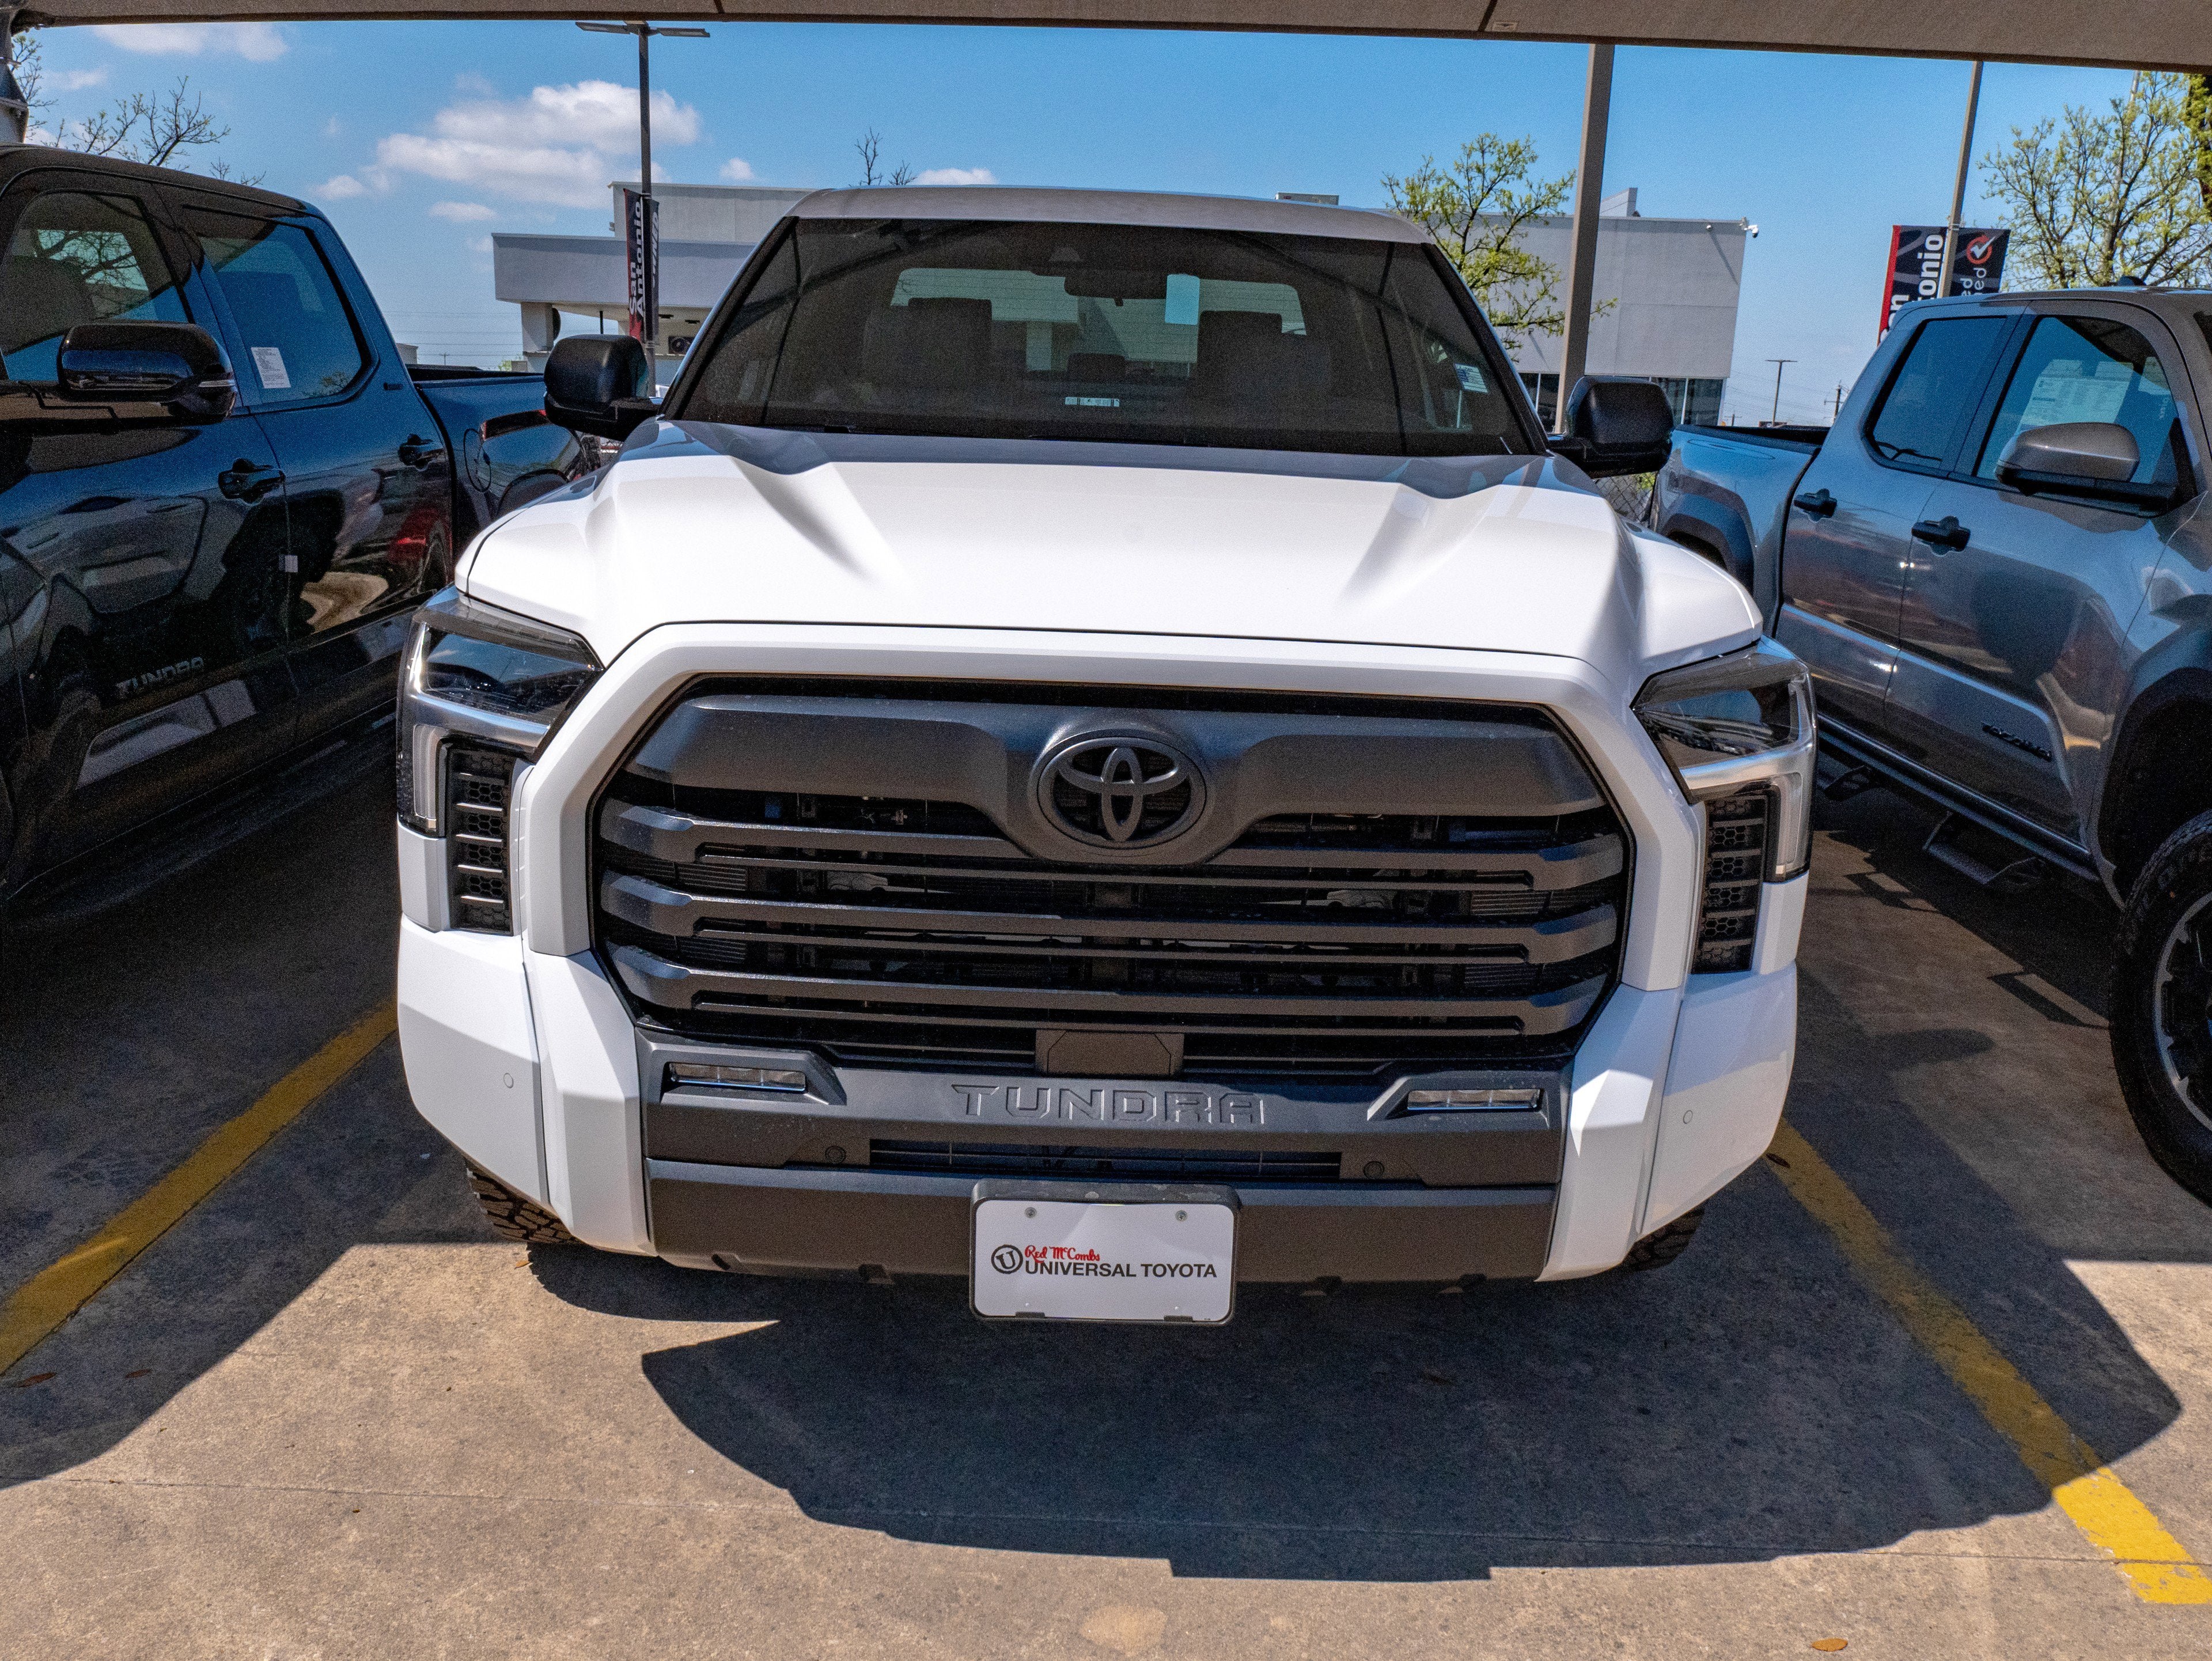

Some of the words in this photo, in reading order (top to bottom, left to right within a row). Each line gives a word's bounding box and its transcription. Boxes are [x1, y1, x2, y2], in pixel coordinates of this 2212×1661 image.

[634, 202, 643, 317] Antonio
[1917, 234, 1944, 301] onio
[951, 1084, 1264, 1124] TUNDRA
[1024, 1245, 1047, 1263] Red
[1049, 1246, 1100, 1261] McCombs
[1025, 1261, 1137, 1277] UNIVERSAL
[1141, 1263, 1217, 1277] TOYOTA
